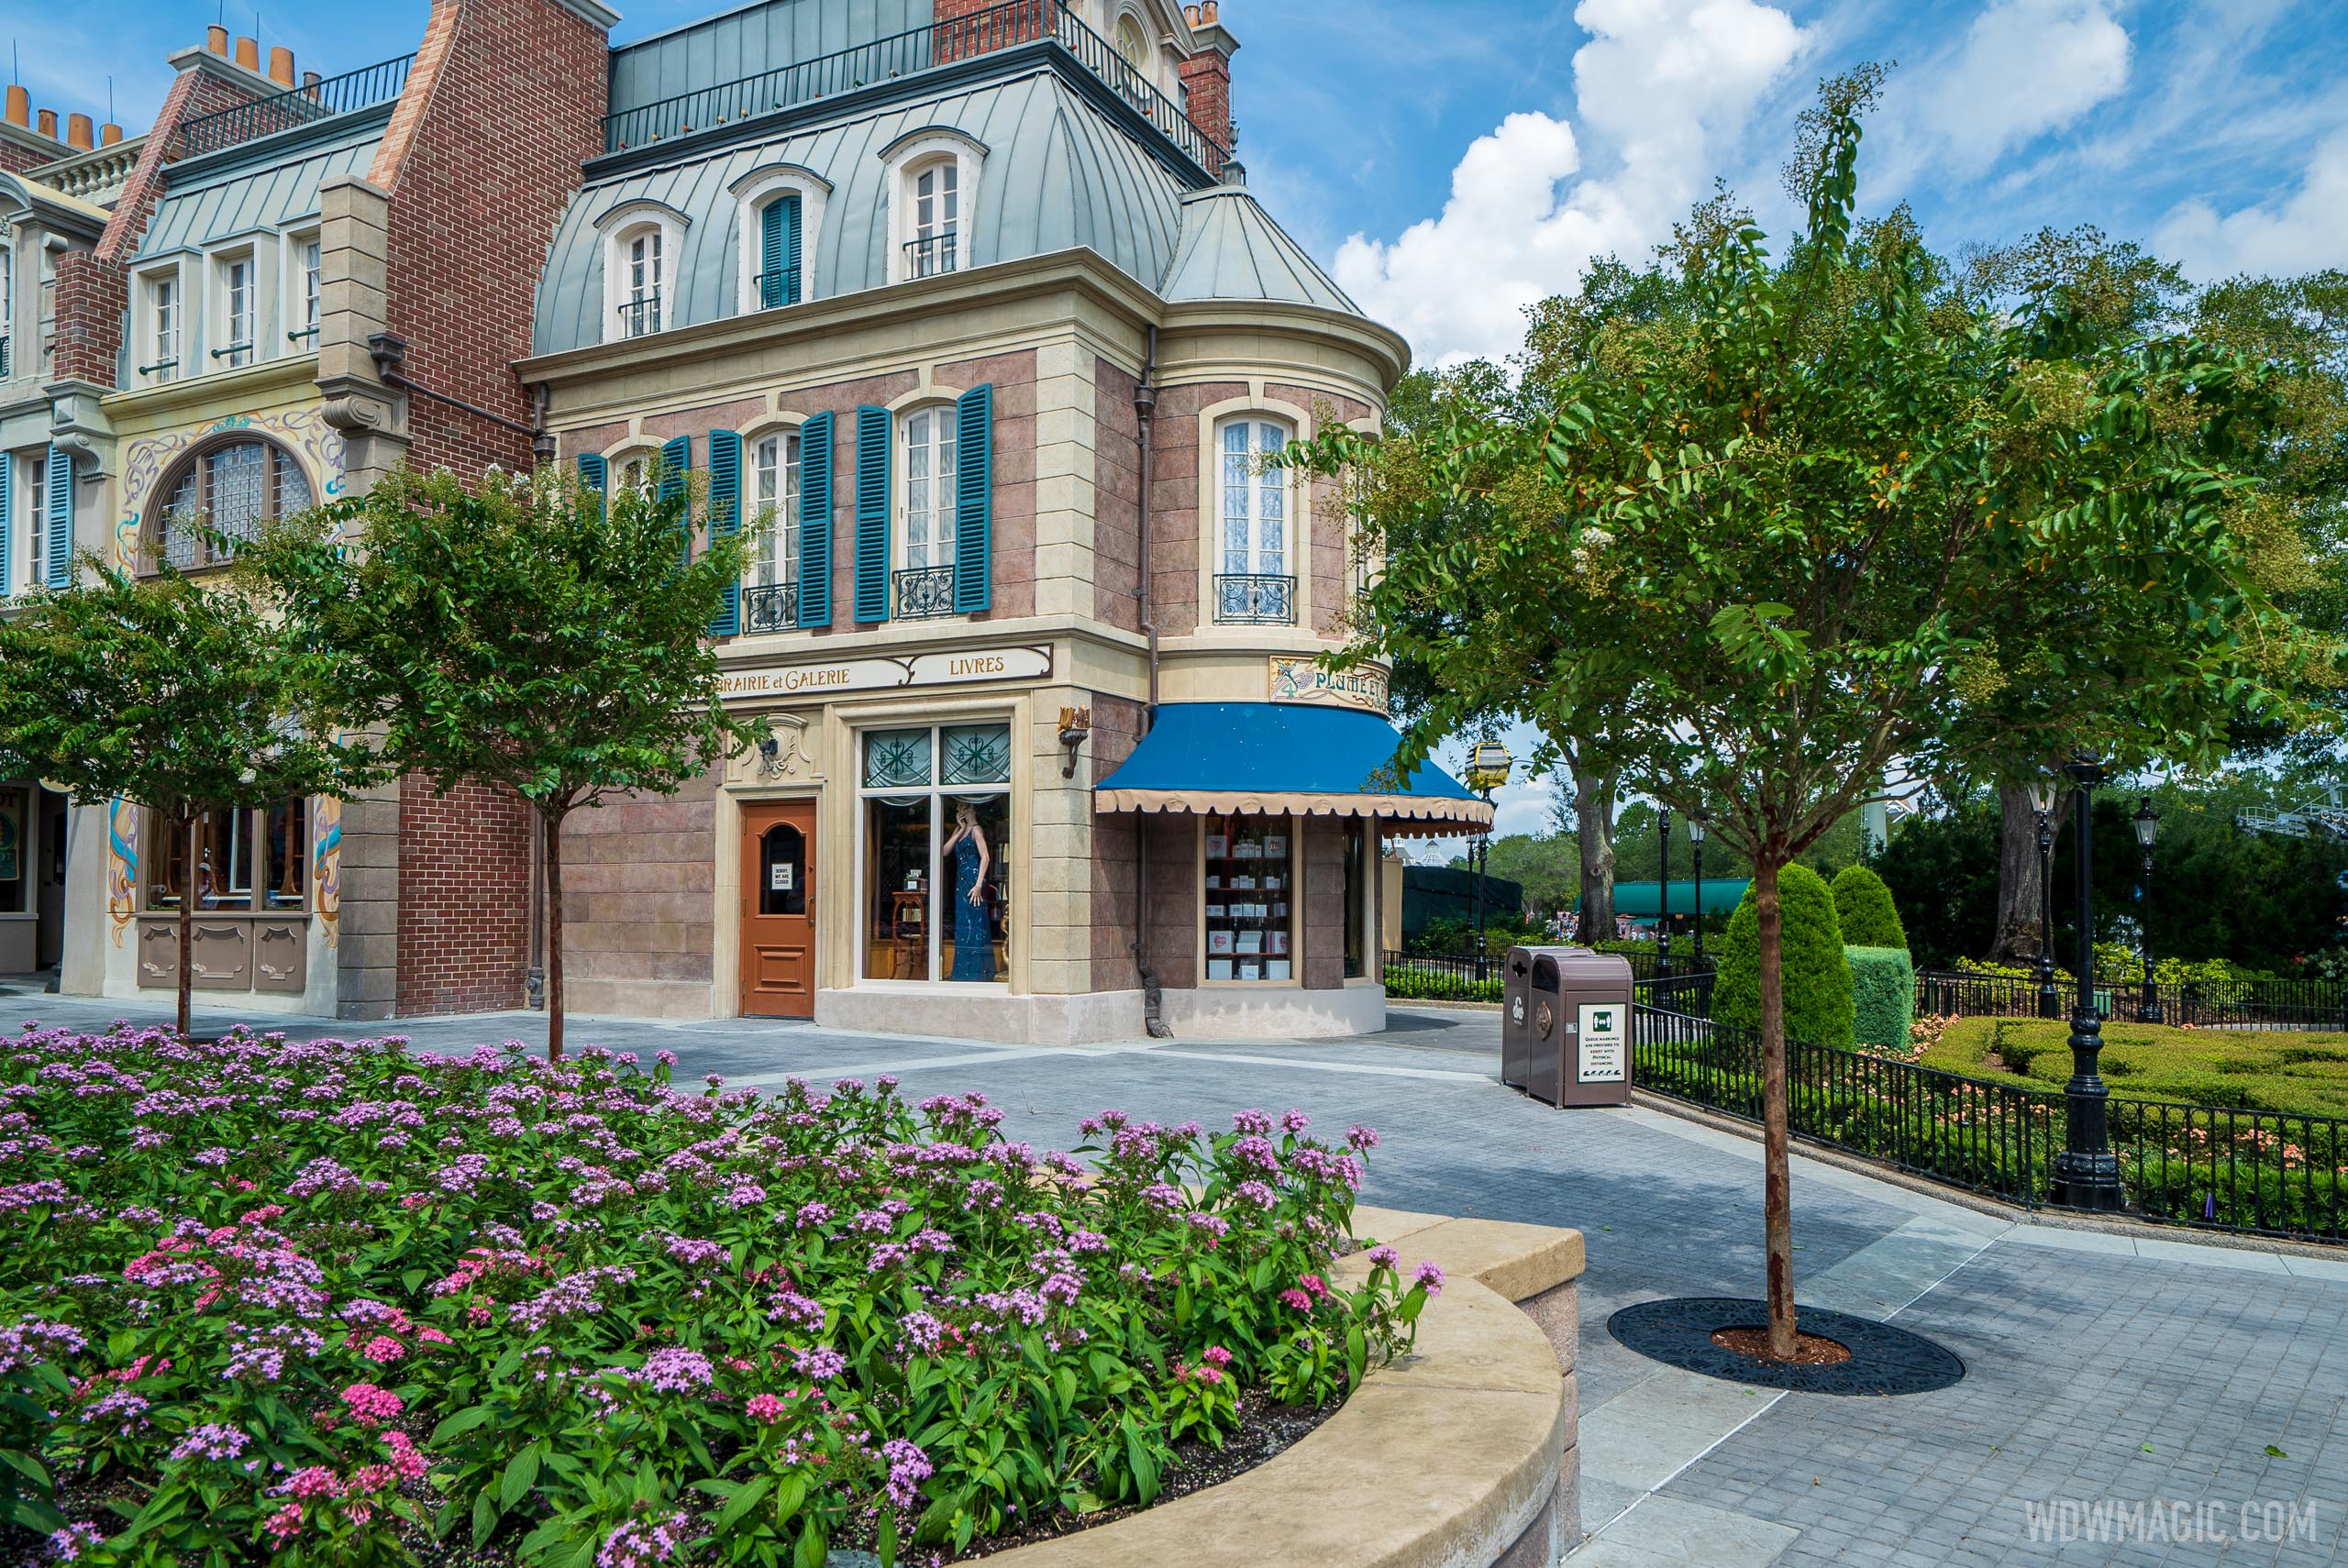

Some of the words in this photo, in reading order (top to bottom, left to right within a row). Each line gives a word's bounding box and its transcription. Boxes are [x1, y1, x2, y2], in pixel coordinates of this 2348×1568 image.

[950, 657, 1004, 675] LIVRES
[772, 676, 782, 688] et
[785, 668, 850, 690] GALERIE
[1315, 672, 1368, 694] PLUME
